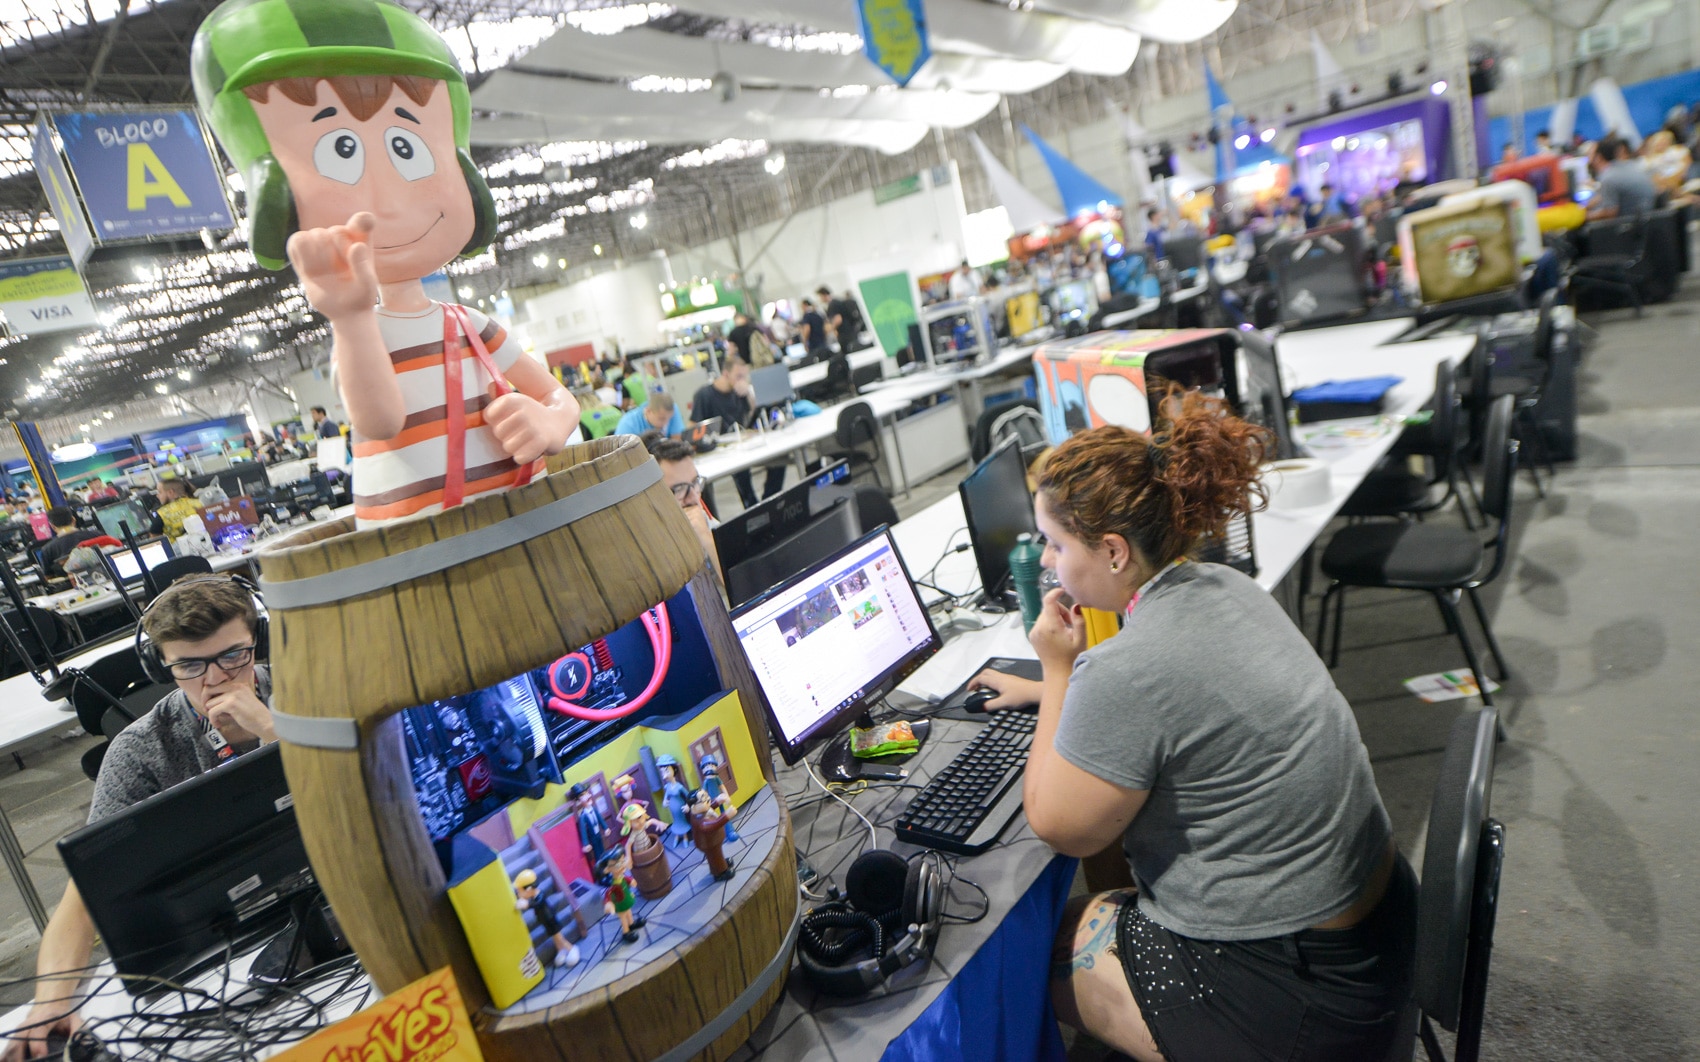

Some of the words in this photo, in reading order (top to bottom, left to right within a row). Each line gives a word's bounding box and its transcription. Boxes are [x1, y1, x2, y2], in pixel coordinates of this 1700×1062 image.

[95, 118, 168, 149] BLOCO
[47, 165, 78, 234] A
[127, 143, 192, 211] A
[29, 304, 73, 321] VISA
